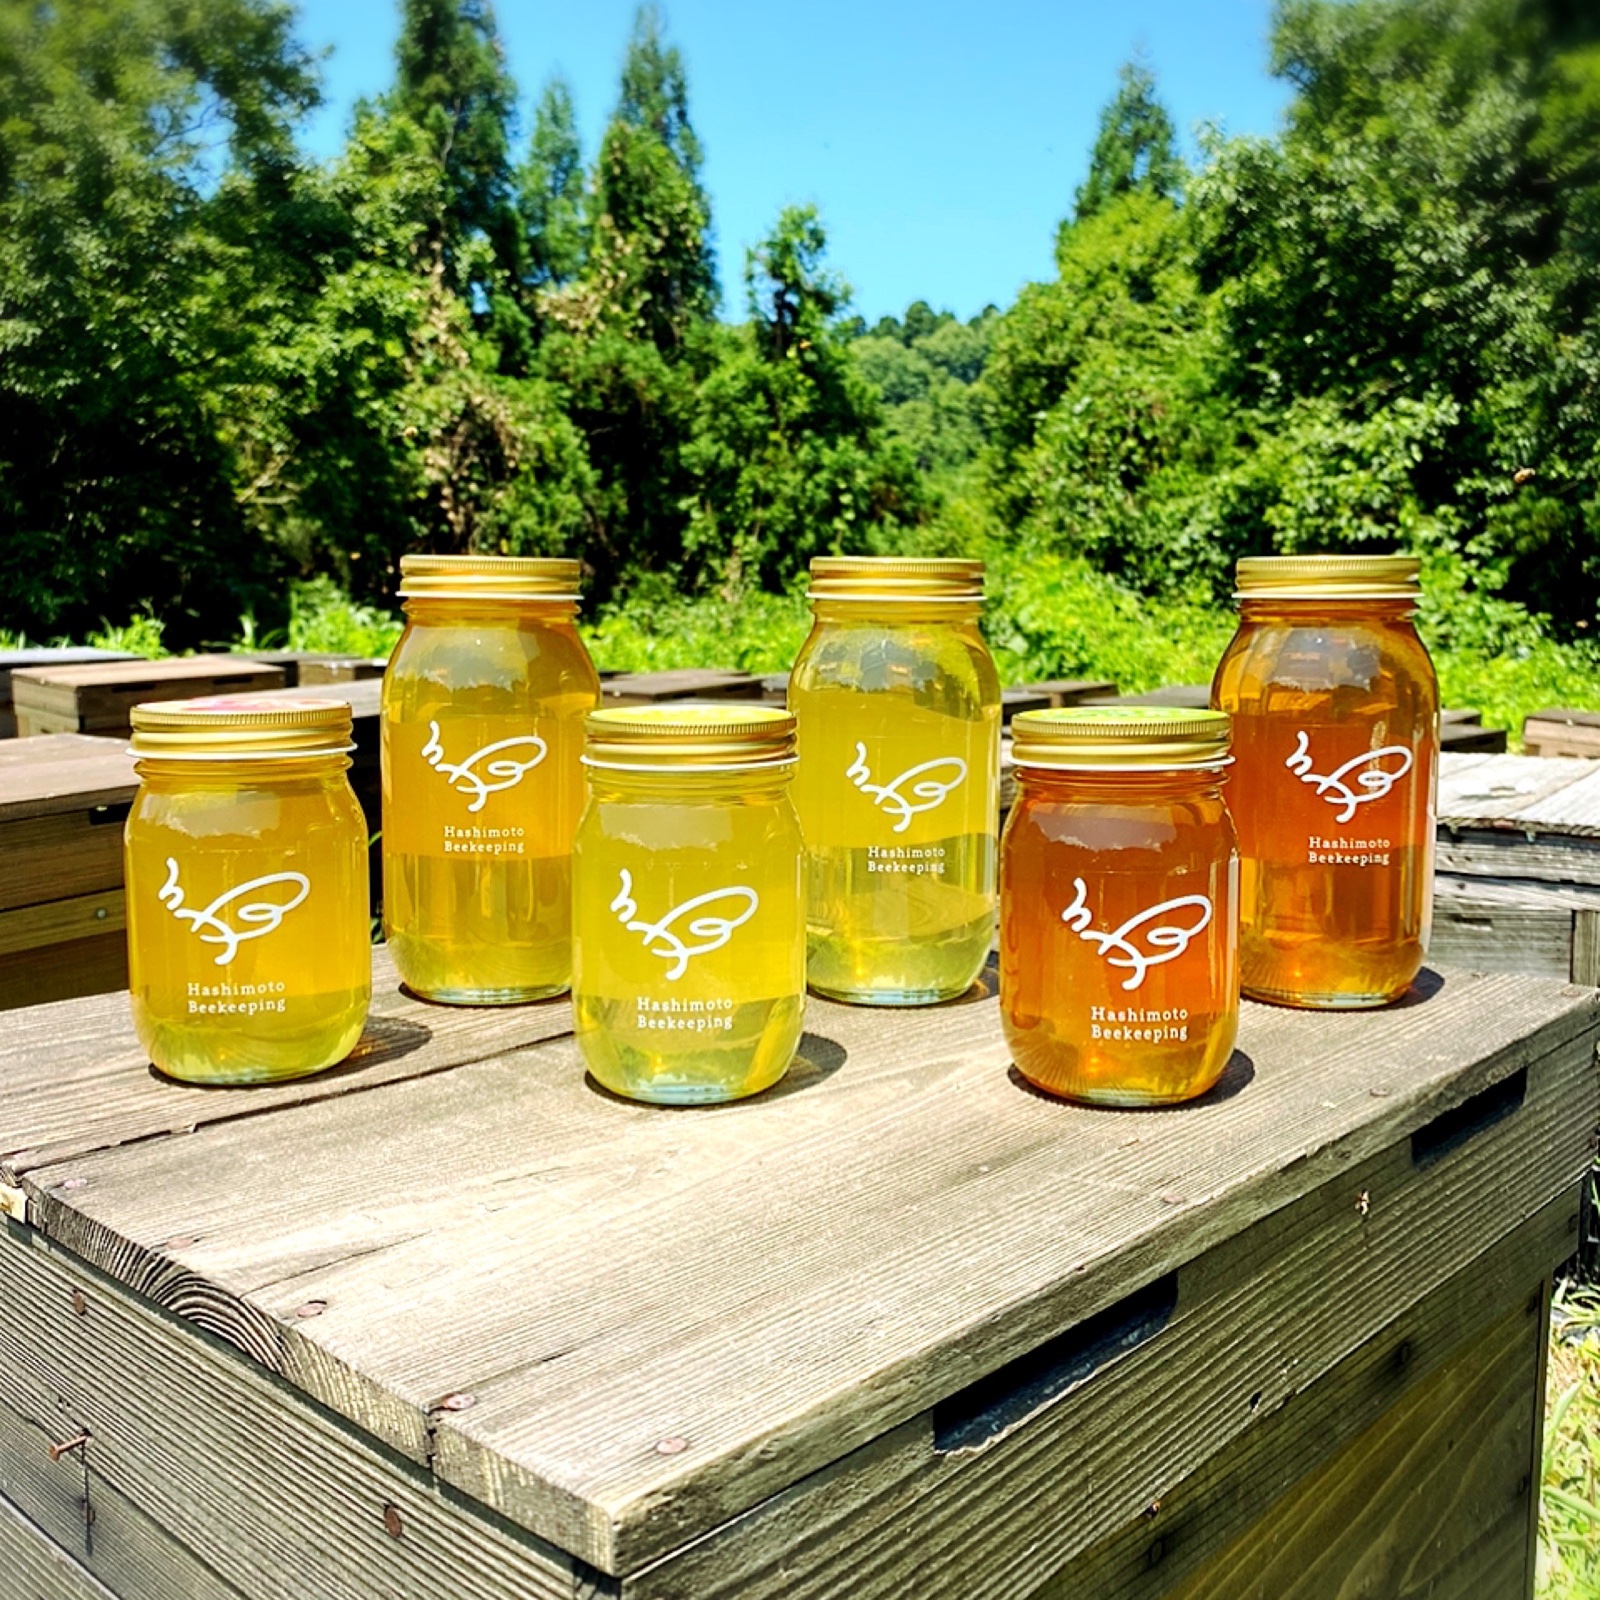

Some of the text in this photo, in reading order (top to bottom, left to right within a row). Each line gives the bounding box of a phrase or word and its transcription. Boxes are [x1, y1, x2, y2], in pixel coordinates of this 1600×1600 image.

[443, 825, 524, 838] Hashimoto
[443, 841, 524, 855] Beekeeping
[1309, 837, 1391, 850] Hashimoto
[867, 846, 945, 858] Hashimoto
[1308, 851, 1390, 866] Beekeeping
[867, 861, 945, 875] Beekeeping
[187, 981, 286, 996] Hashimoto
[188, 998, 286, 1015] Beekeeping
[637, 997, 733, 1012] Hashimoto
[1091, 1006, 1189, 1021] Hashimoto
[637, 1014, 733, 1032] Beekeeping
[1091, 1024, 1188, 1043] Beekeeping
